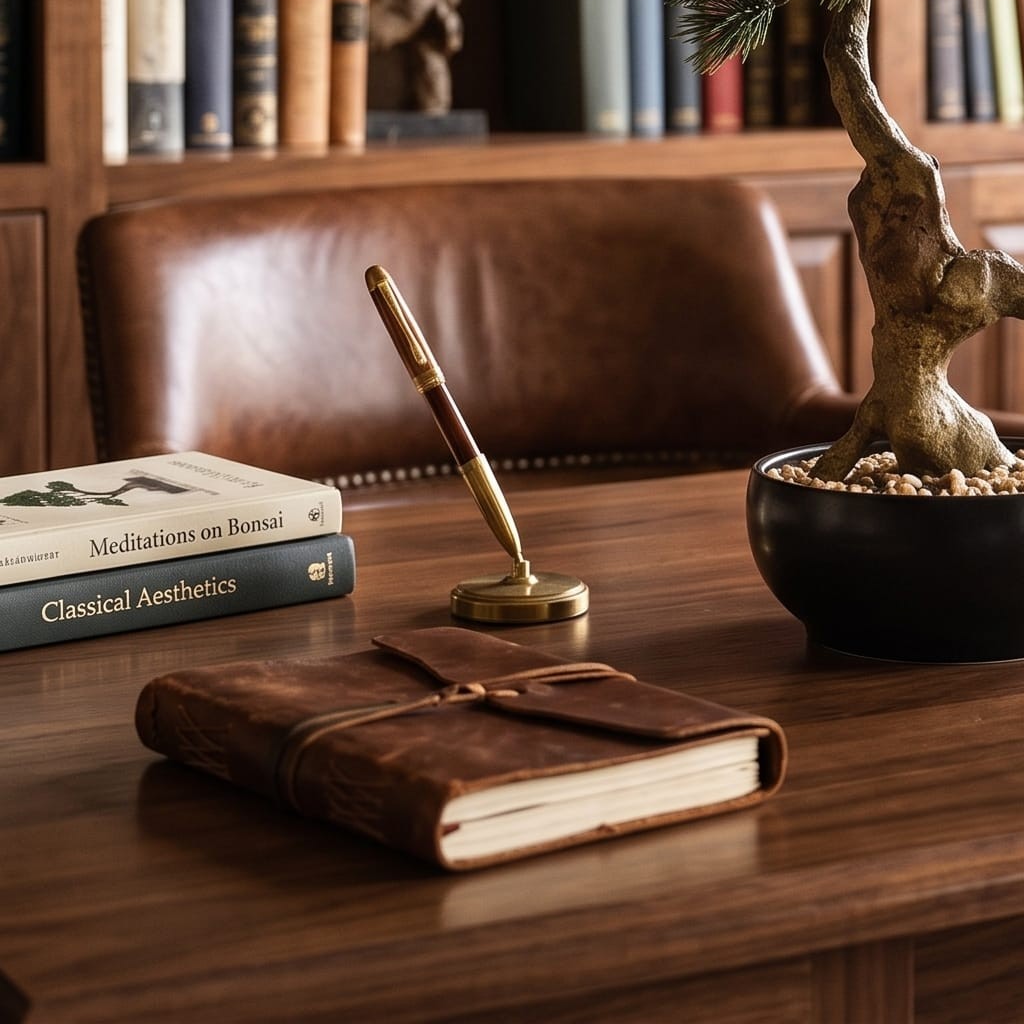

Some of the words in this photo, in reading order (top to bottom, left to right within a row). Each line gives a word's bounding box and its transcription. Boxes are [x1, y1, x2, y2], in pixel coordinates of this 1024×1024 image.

[89, 528, 196, 558] Meditations
[200, 525, 223, 541] on
[227, 510, 284, 537] Bonsai
[40, 589, 132, 624] Classical
[136, 576, 237, 608] Aesthetics
